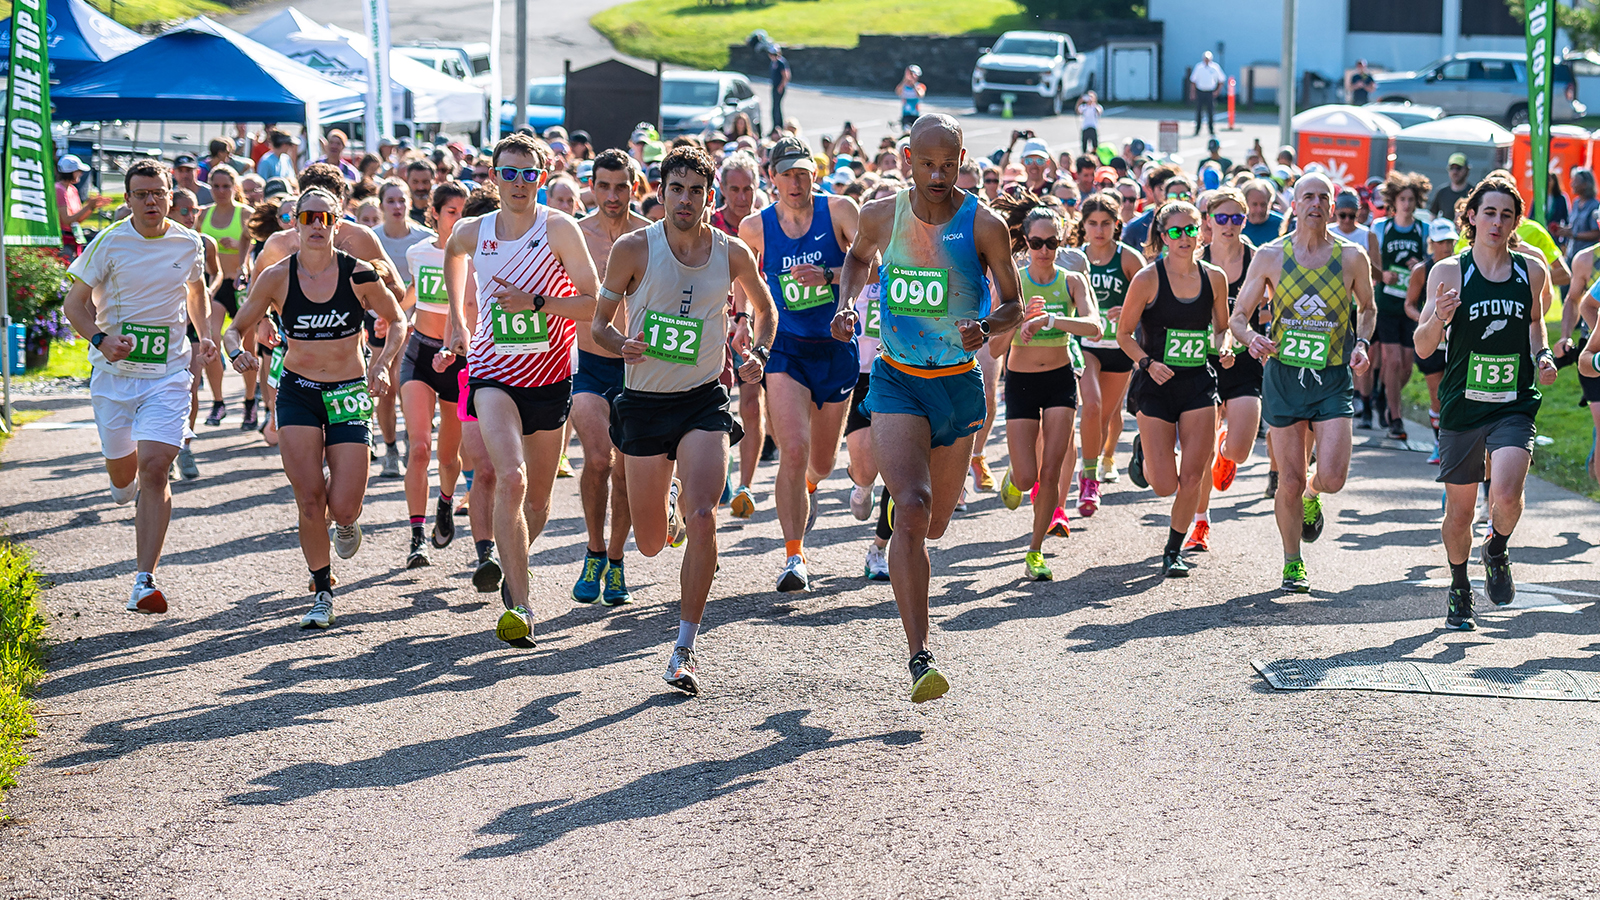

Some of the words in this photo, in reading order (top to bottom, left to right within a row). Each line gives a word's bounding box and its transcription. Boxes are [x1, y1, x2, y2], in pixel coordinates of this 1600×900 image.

[15, 10, 41, 62] TOP
[12, 64, 42, 114] THE
[11, 118, 42, 152] TO
[10, 155, 48, 223] RACE
[942, 232, 964, 242] HOKA
[1387, 239, 1419, 253] STOWE
[782, 250, 822, 269] Dirigo
[890, 277, 944, 307] 090
[1090, 273, 1123, 294] OWE
[658, 315, 676, 324] DELTA
[676, 319, 698, 328] DENTAL
[1280, 317, 1301, 326] GREEN
[1469, 299, 1525, 322] STOWE
[497, 313, 541, 335] 161
[125, 333, 166, 356] 018
[649, 323, 697, 354] 132
[1167, 338, 1205, 358] 242
[1283, 337, 1325, 362] 252
[1473, 363, 1515, 385] 133
[330, 392, 372, 415] 108
